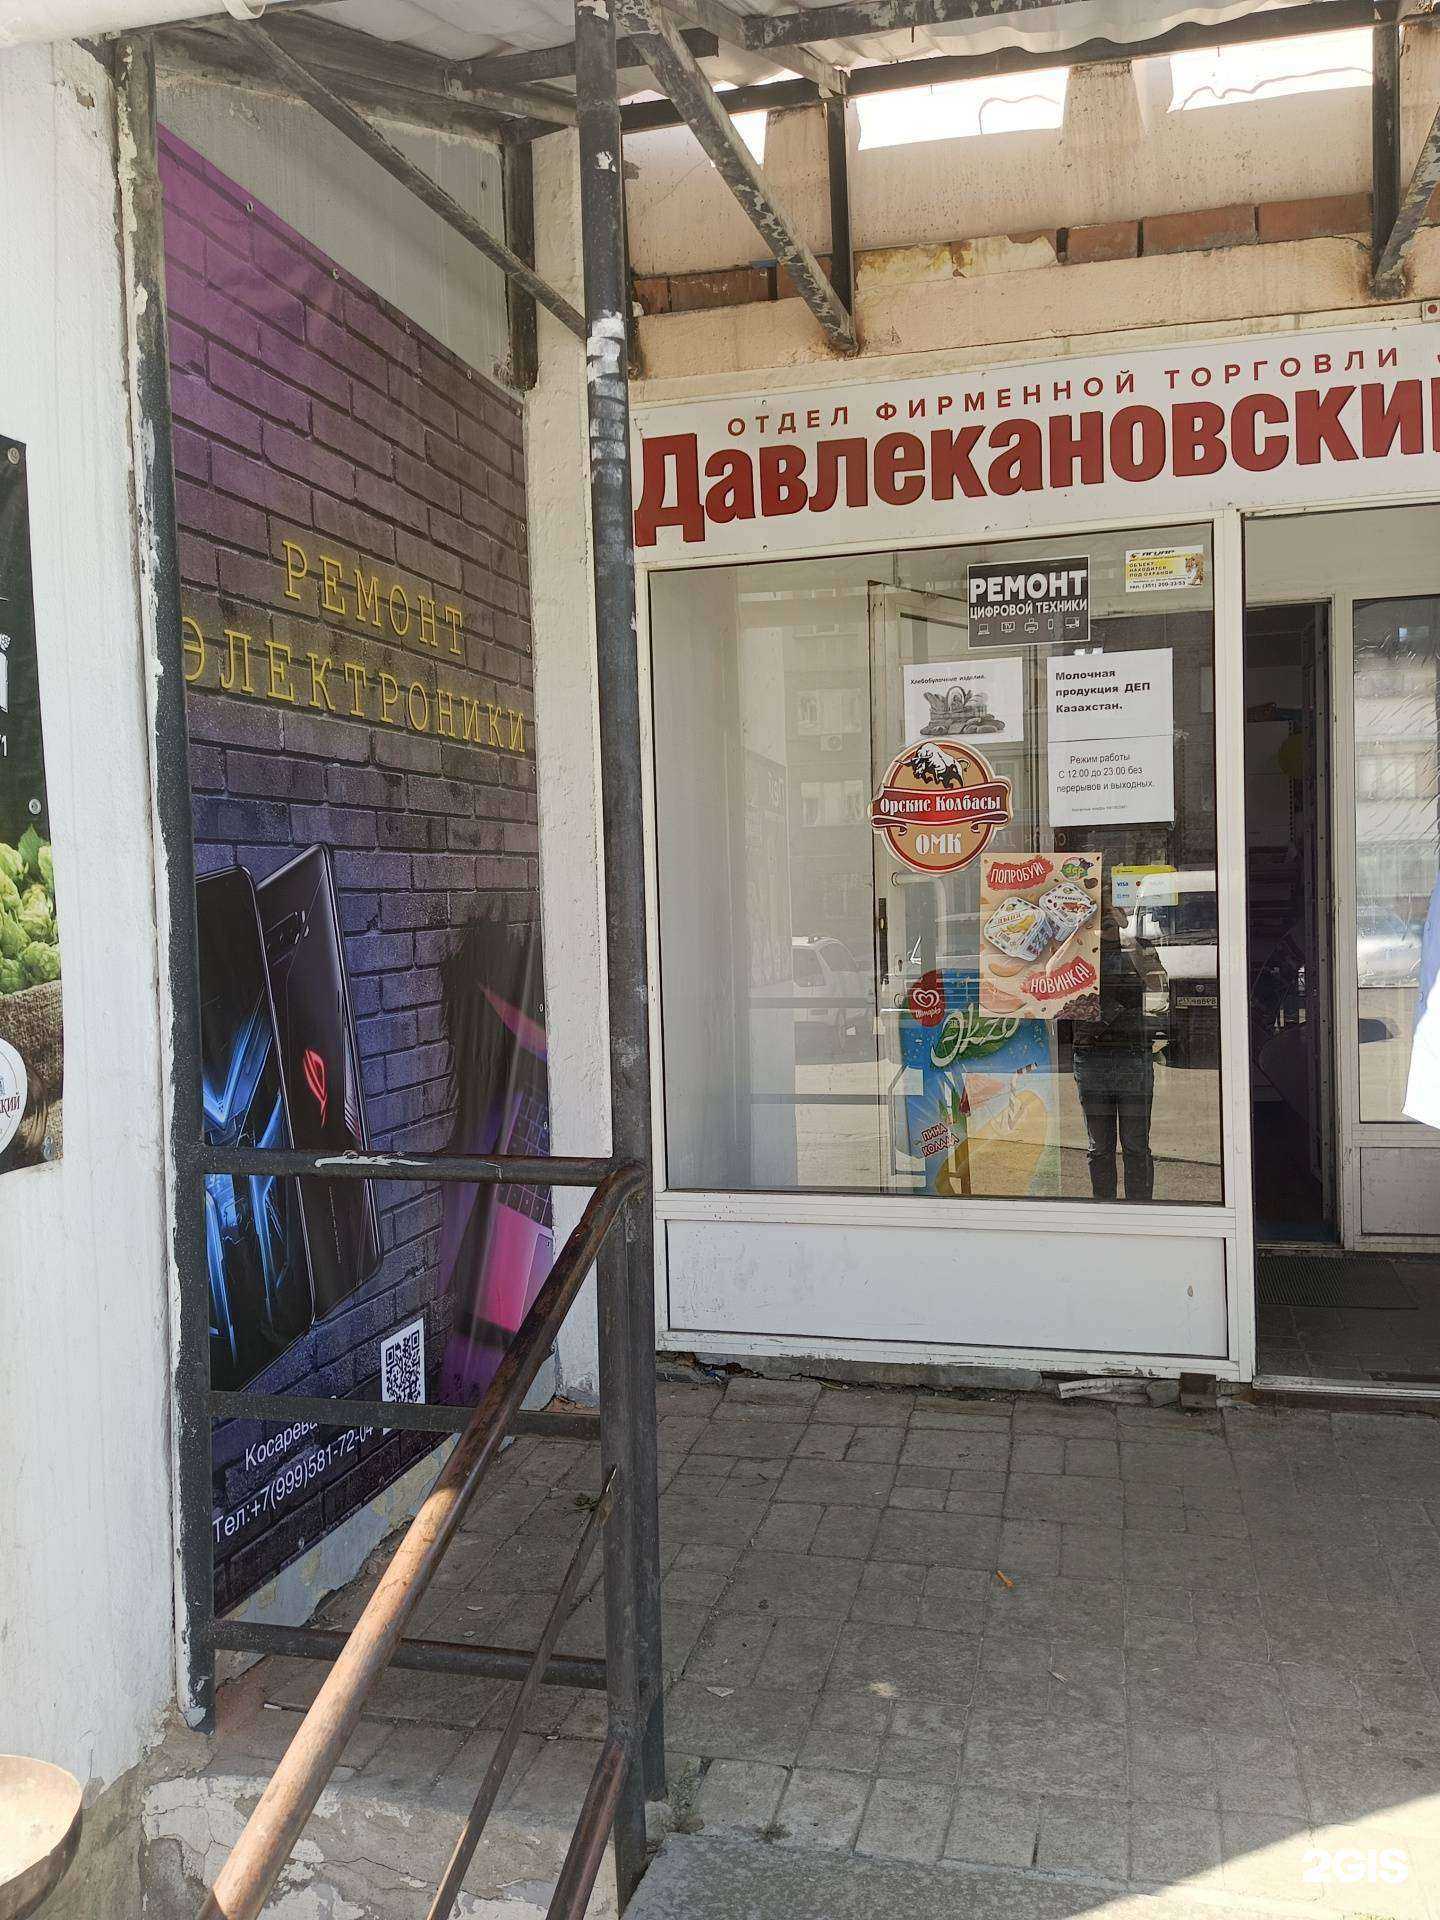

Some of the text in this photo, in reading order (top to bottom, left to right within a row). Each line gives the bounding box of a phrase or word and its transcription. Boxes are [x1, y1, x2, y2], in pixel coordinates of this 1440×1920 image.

[727, 347, 1398, 437] ОТДЕЛ ФИРМЕННОЙ ТОРГОВЛИ
[633, 376, 1440, 548] Давлекановски
[970, 570, 1087, 603] РЕМОНТ
[282, 540, 463, 655] РЕМОНТ
[970, 599, 1087, 620] ЦИФРОВОЙ ТЕХНИКИ
[182, 616, 526, 752] ЭЛЕКТРОНИКИ
[1055, 670, 1116, 680] Молочная
[1055, 682, 1150, 698] продукция ДЕП
[1056, 703, 1123, 713] Казахстан.
[1070, 753, 1130, 764] Режим работы
[1091, 769, 1102, 778] до
[1127, 766, 1143, 774] без
[1056, 783, 1101, 794] перерывов
[880, 795, 1001, 815] Орские Колбасы
[915, 833, 962, 855] ОМК
[990, 862, 1046, 883] ПОПРОБУЙ!
[1030, 962, 1092, 993] НОВИНКА!
[922, 1123, 948, 1141] ПИНА
